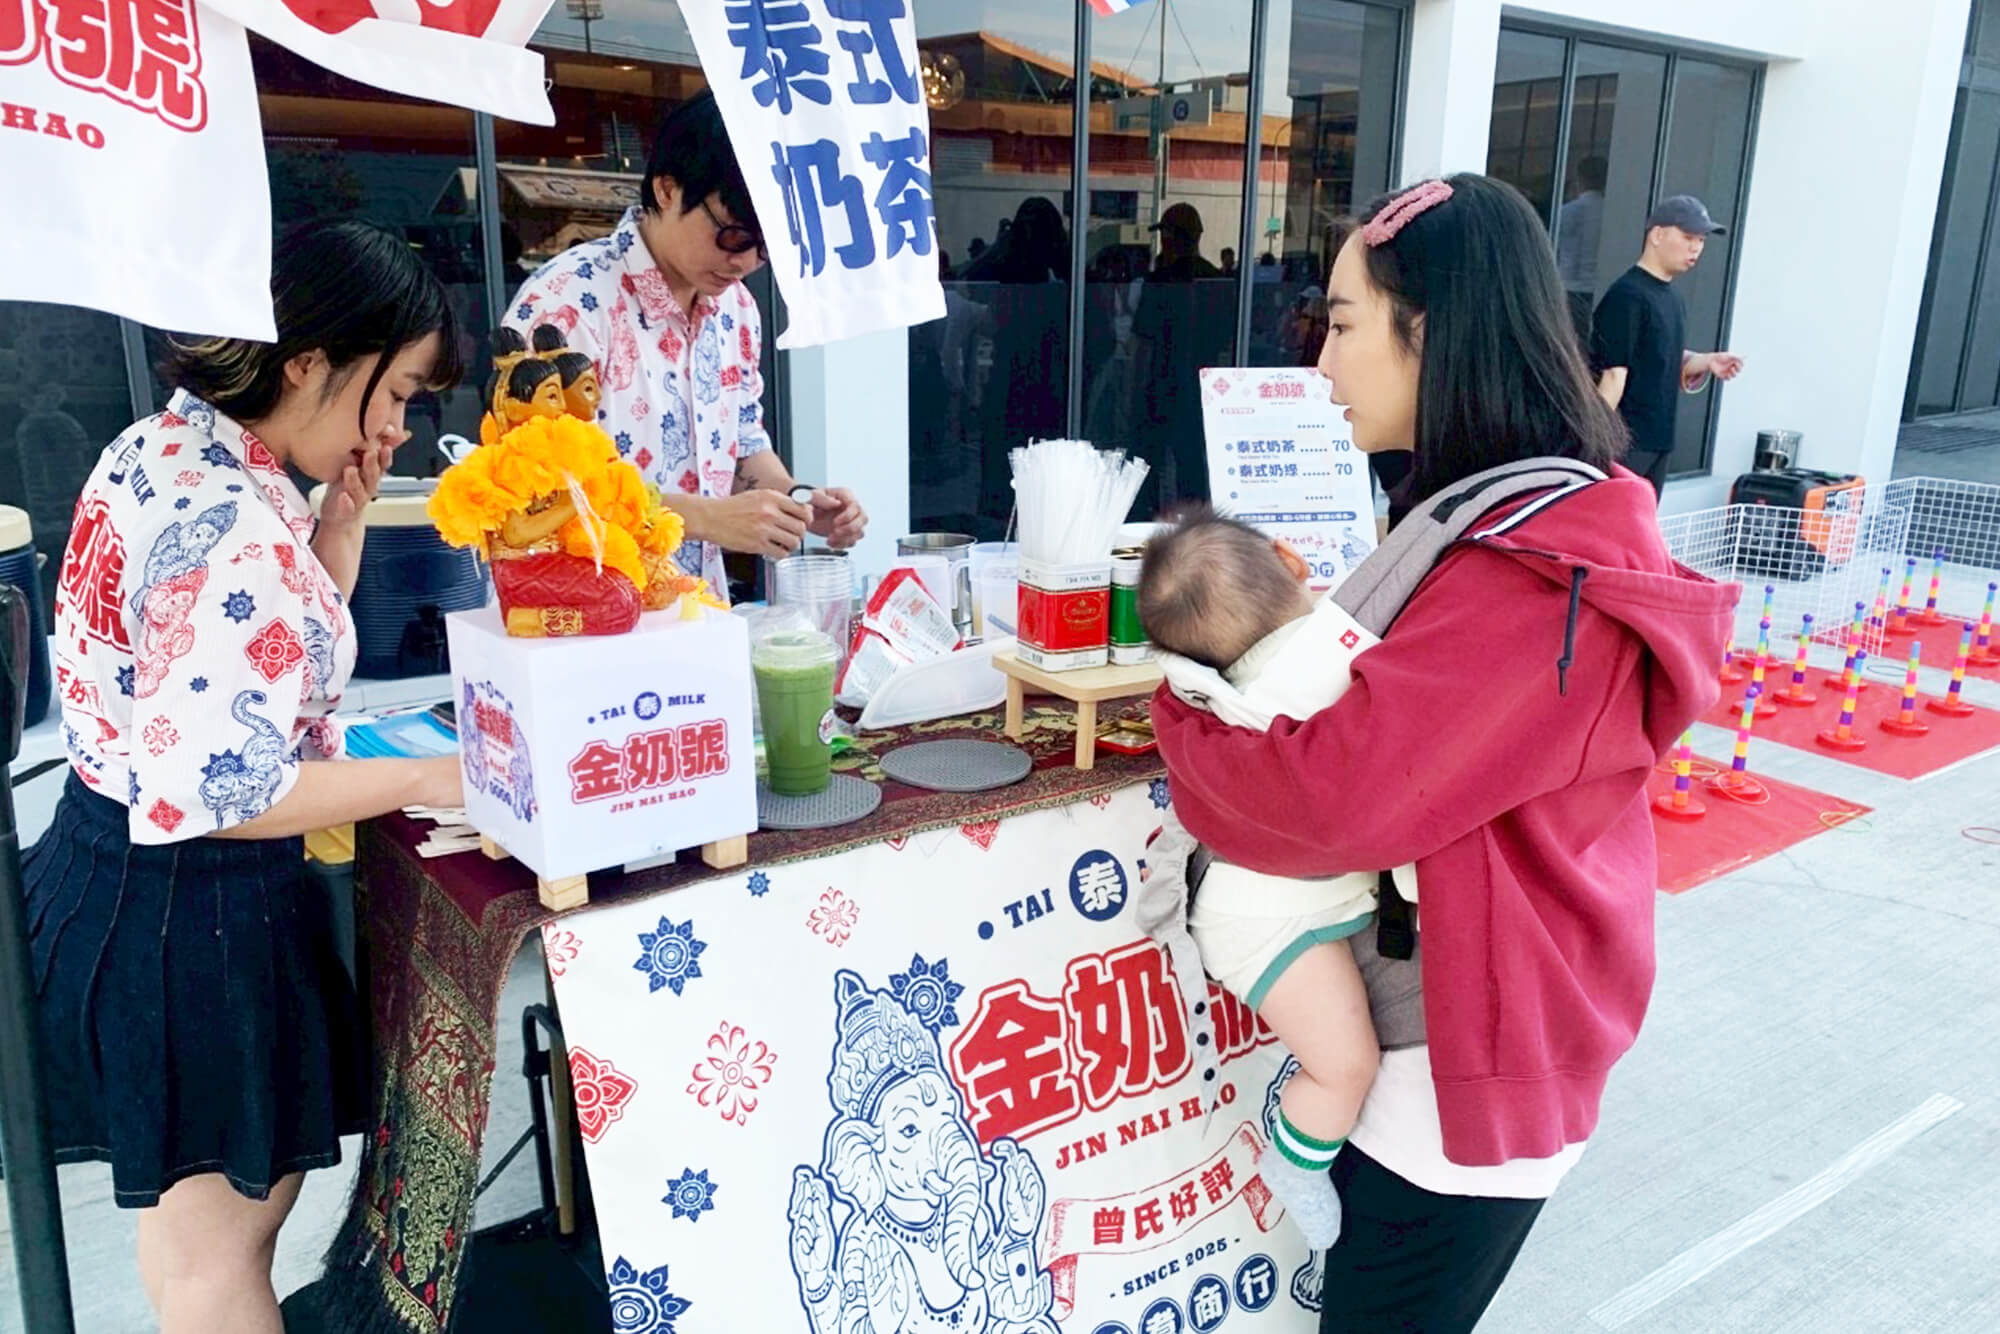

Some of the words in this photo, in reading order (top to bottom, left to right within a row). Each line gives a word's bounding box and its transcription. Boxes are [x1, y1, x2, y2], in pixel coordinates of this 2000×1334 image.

[724, 0, 920, 115] 泰式
[1, 103, 105, 149] HAO
[770, 126, 936, 278] 奶茶
[1237, 440, 1295, 453] 泰式奶茶
[1332, 440, 1350, 452] 70
[1335, 463, 1352, 475] 70
[600, 706, 626, 720] TAI
[668, 694, 705, 706] MILK
[570, 720, 727, 803] 金奶號
[610, 801, 634, 813] JIN
[1003, 888, 1055, 929] TAI
[1075, 858, 1124, 913] 泰
[952, 938, 1279, 1152] 金奶
[1055, 1131, 1108, 1169] JIN
[1119, 1108, 1172, 1146] NAI
[1181, 1082, 1237, 1122] HO
[1092, 1156, 1235, 1246] 曾氏好評
[1122, 1259, 1180, 1297] SINCE
[1184, 1237, 1228, 1267] 2025
